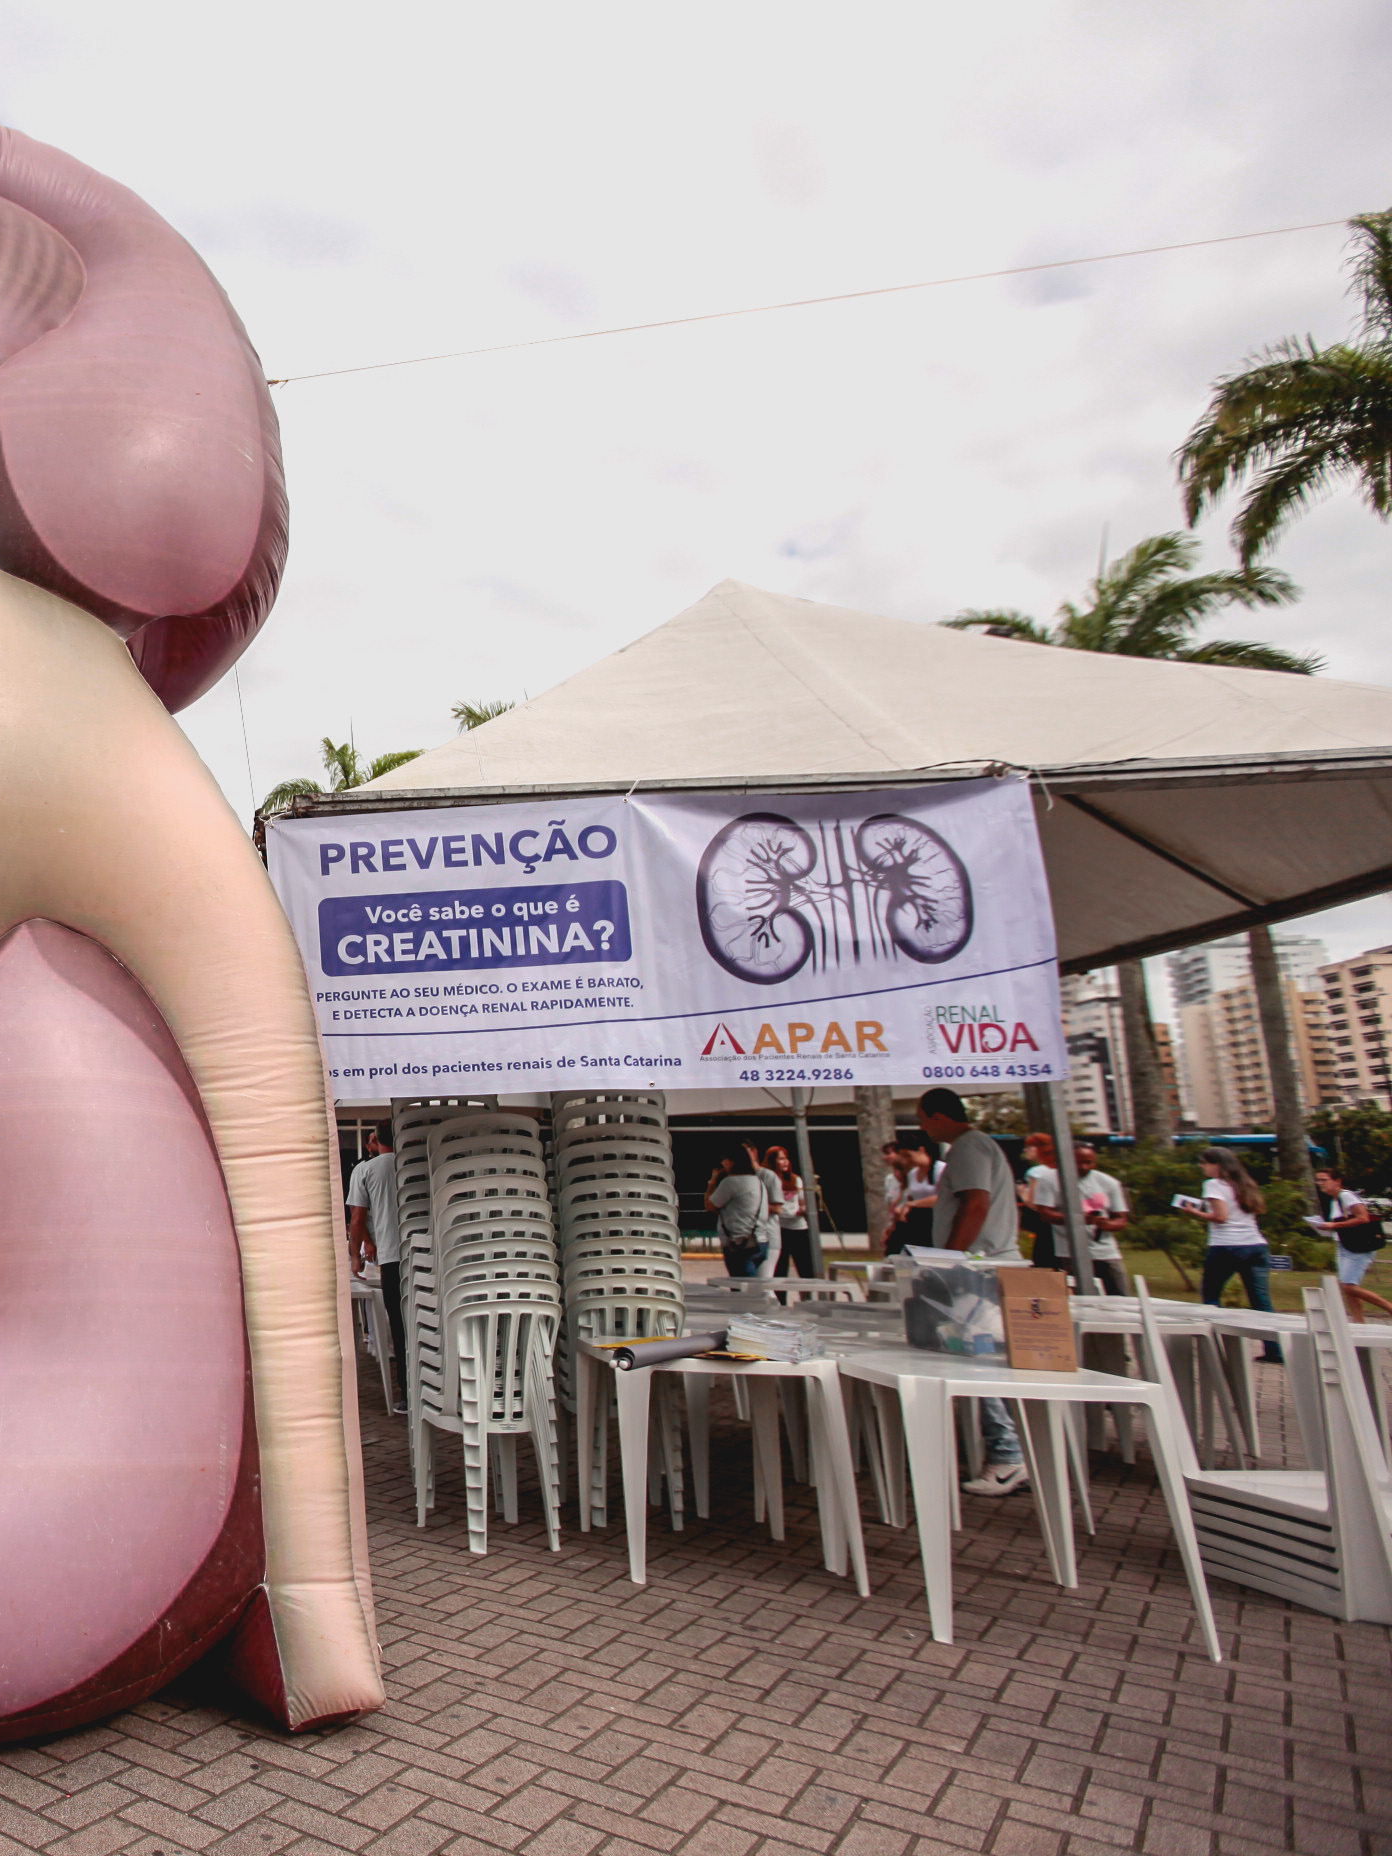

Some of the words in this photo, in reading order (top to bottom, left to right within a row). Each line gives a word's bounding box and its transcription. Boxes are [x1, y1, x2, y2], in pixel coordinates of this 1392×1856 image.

[319, 819, 618, 877] PREVENÇÃO
[365, 904, 423, 924] Você
[429, 901, 484, 920] sabe
[491, 903, 506, 917] o
[513, 899, 558, 921] que
[565, 894, 580, 912] é
[337, 919, 615, 965] CREATININA?
[316, 989, 387, 1002] PERGUNTE
[389, 988, 411, 999] AO
[414, 987, 439, 998] SEU
[443, 983, 504, 996] MÉDICO.
[506, 982, 518, 993] O
[521, 979, 571, 992] EXAME
[575, 976, 584, 989] É
[587, 977, 644, 990] BARATO,
[332, 1010, 341, 1020] E
[343, 1007, 403, 1020] DETECTA
[406, 1006, 416, 1017] A
[419, 1003, 479, 1017] DOENÇA
[482, 1001, 528, 1014] RENAL
[530, 996, 634, 1011] RAPIDAMENTE.
[935, 1005, 1006, 1024] RENAL
[752, 1020, 889, 1055] APAR
[938, 1022, 1040, 1053] VIDA
[343, 1067, 365, 1077] em
[369, 1063, 398, 1079] prol
[402, 1063, 428, 1075] dos
[432, 1061, 503, 1077] pacientes
[507, 1057, 553, 1071] renais
[556, 1056, 576, 1068] de
[580, 1055, 621, 1067] Santa
[623, 1054, 682, 1067] Catarina
[699, 1055, 741, 1063] Associação
[922, 1066, 965, 1078] 0800
[970, 1065, 1001, 1077] 648
[1005, 1063, 1052, 1077] 4354
[739, 1070, 759, 1081] 48
[765, 1068, 854, 1081] 3224.9286
